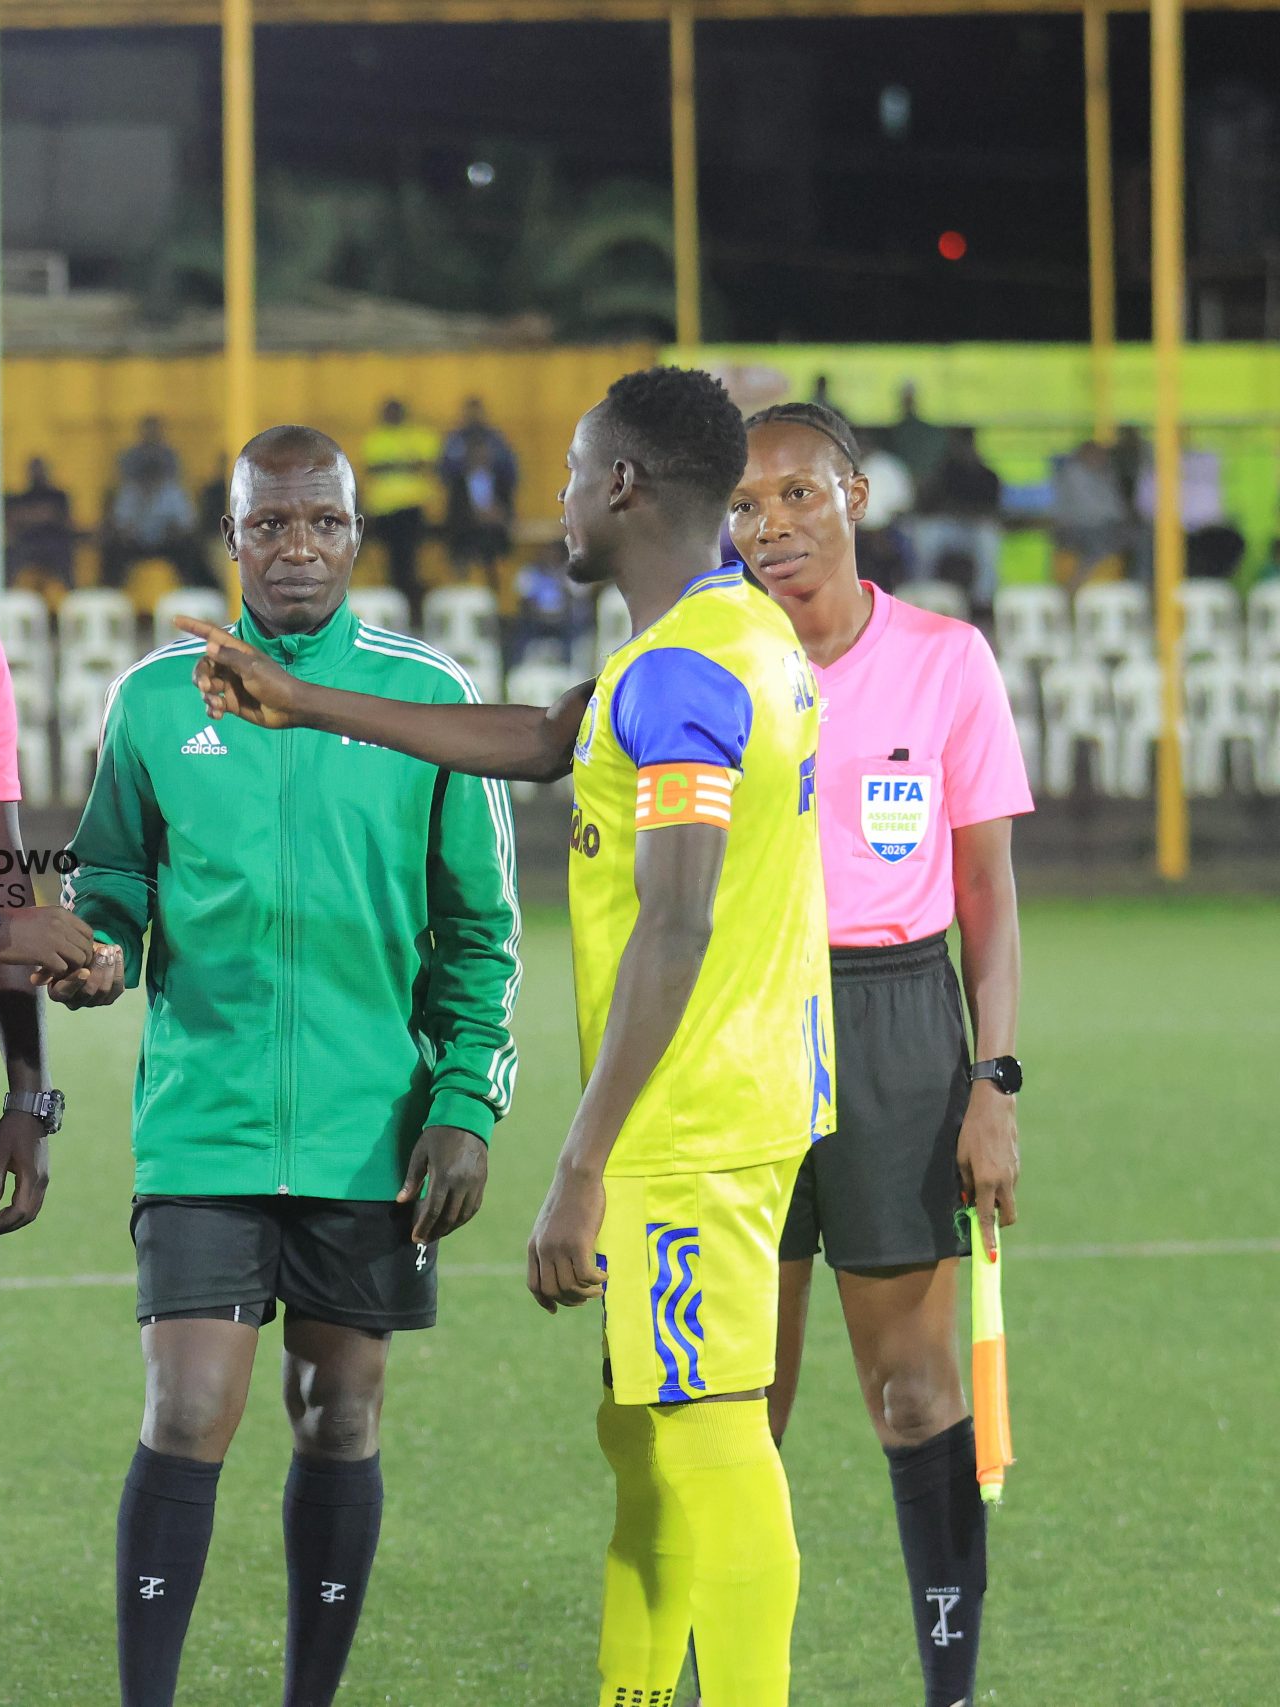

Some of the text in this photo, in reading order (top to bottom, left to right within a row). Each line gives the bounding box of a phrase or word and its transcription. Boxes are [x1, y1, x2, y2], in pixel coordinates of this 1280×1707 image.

[181, 743, 228, 756] adidas
[656, 772, 688, 815] C
[867, 781, 923, 801] FIFA
[867, 812, 922, 821] ASSISTANT
[871, 822, 918, 832] REFEREE
[880, 845, 907, 856] 2026
